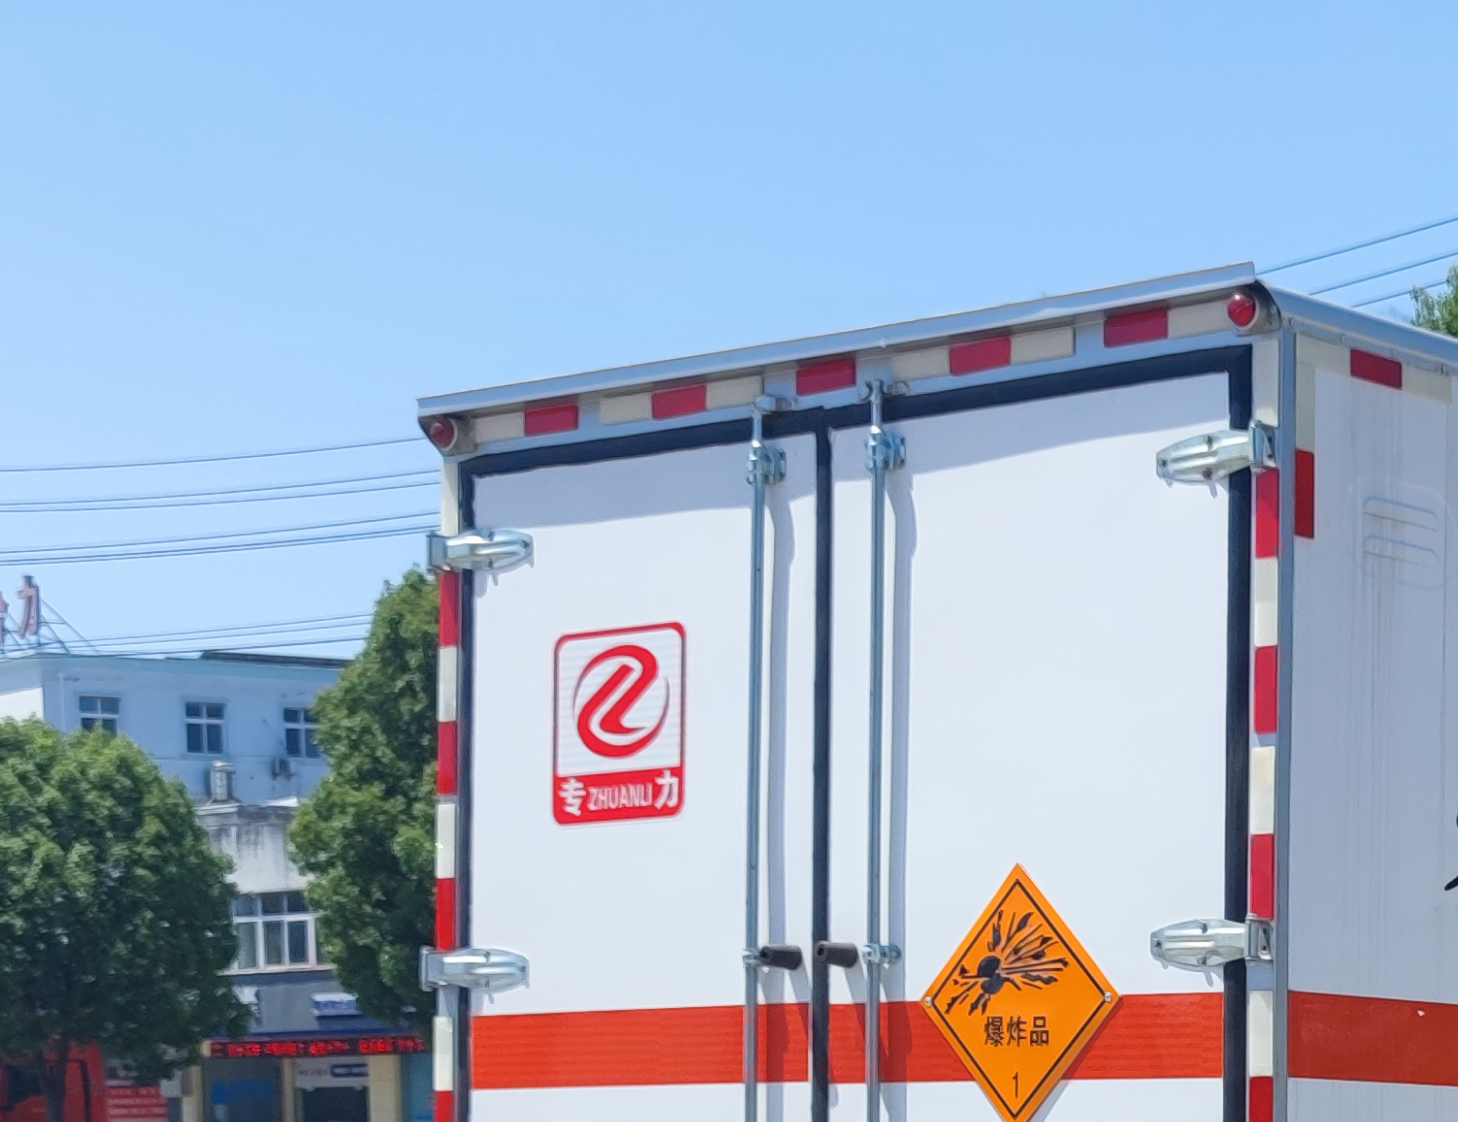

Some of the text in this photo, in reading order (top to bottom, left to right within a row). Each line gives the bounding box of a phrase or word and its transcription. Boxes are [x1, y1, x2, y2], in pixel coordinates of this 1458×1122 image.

[557, 769, 680, 817] 专 ZHUANLI 力
[984, 1015, 1050, 1047] 爆炸品
[1012, 1071, 1019, 1099] 1
